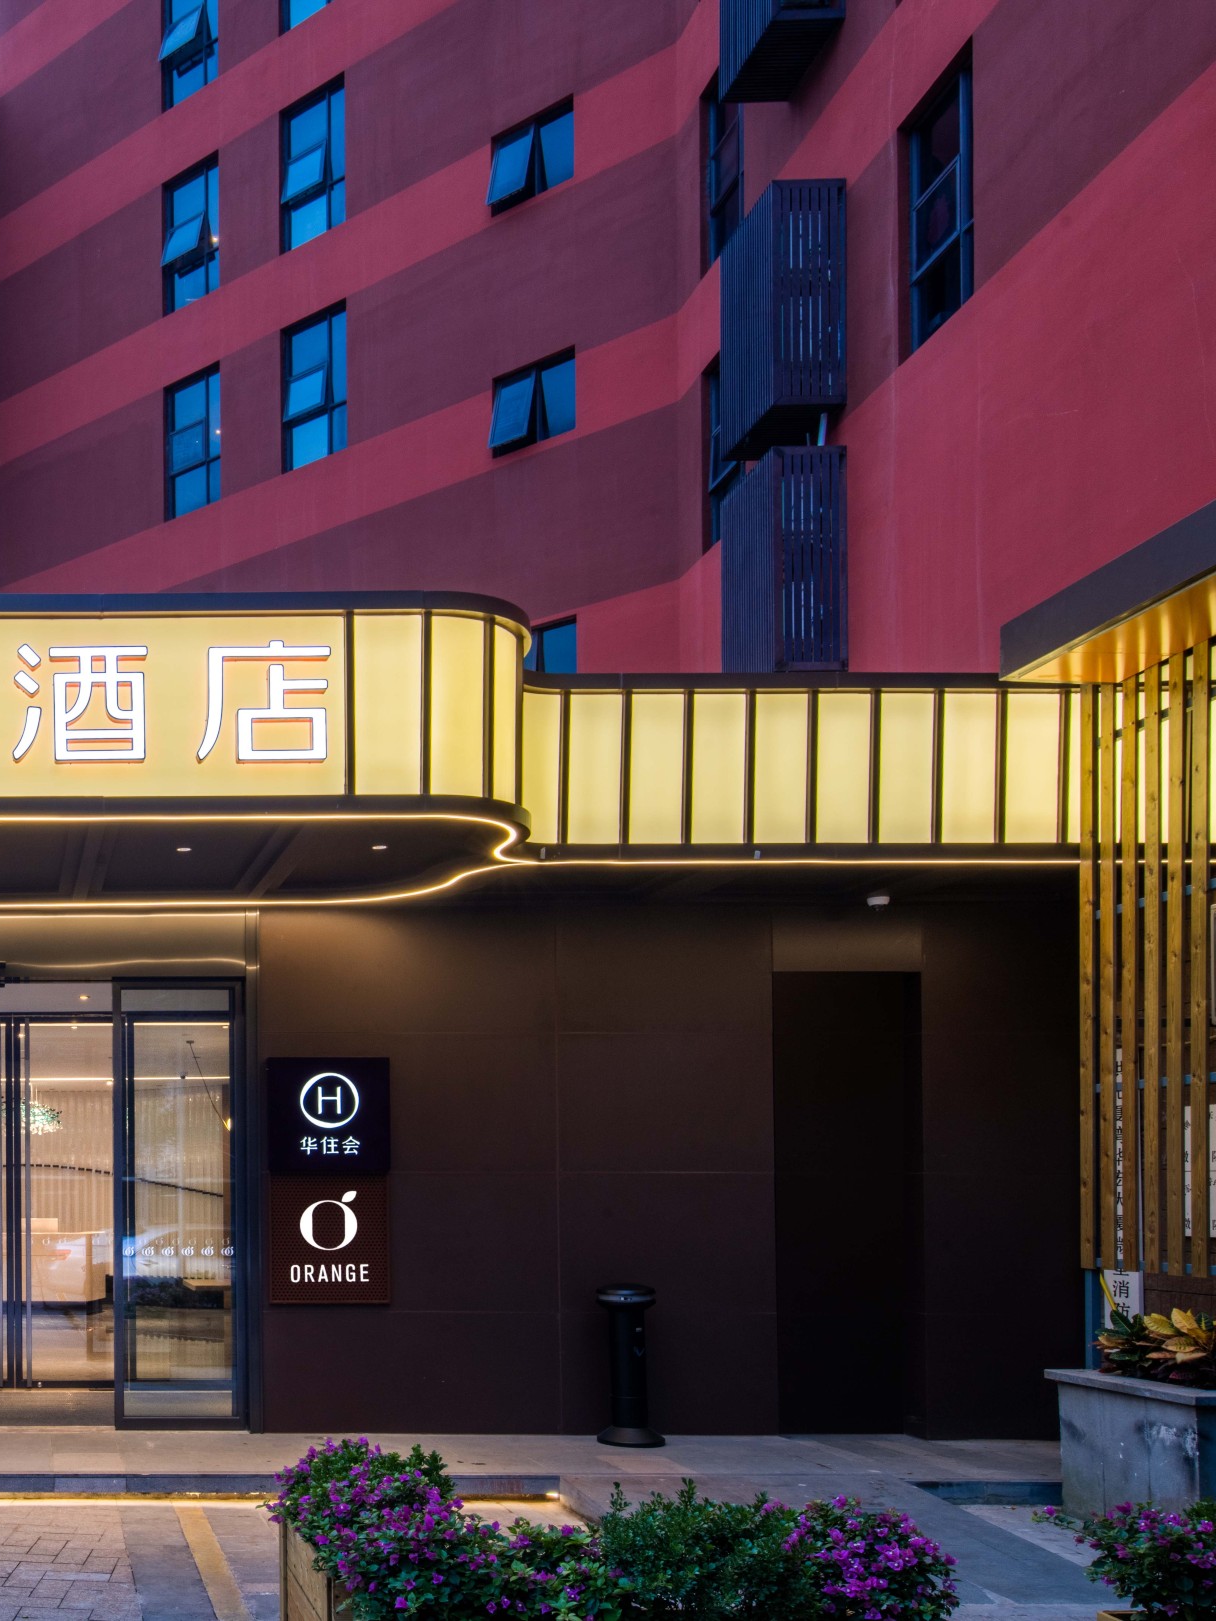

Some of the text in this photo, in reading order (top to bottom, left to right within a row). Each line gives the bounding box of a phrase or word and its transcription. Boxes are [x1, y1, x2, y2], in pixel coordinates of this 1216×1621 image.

[299, 1136, 361, 1155] 华住会
[290, 1263, 370, 1284] ORANGE
